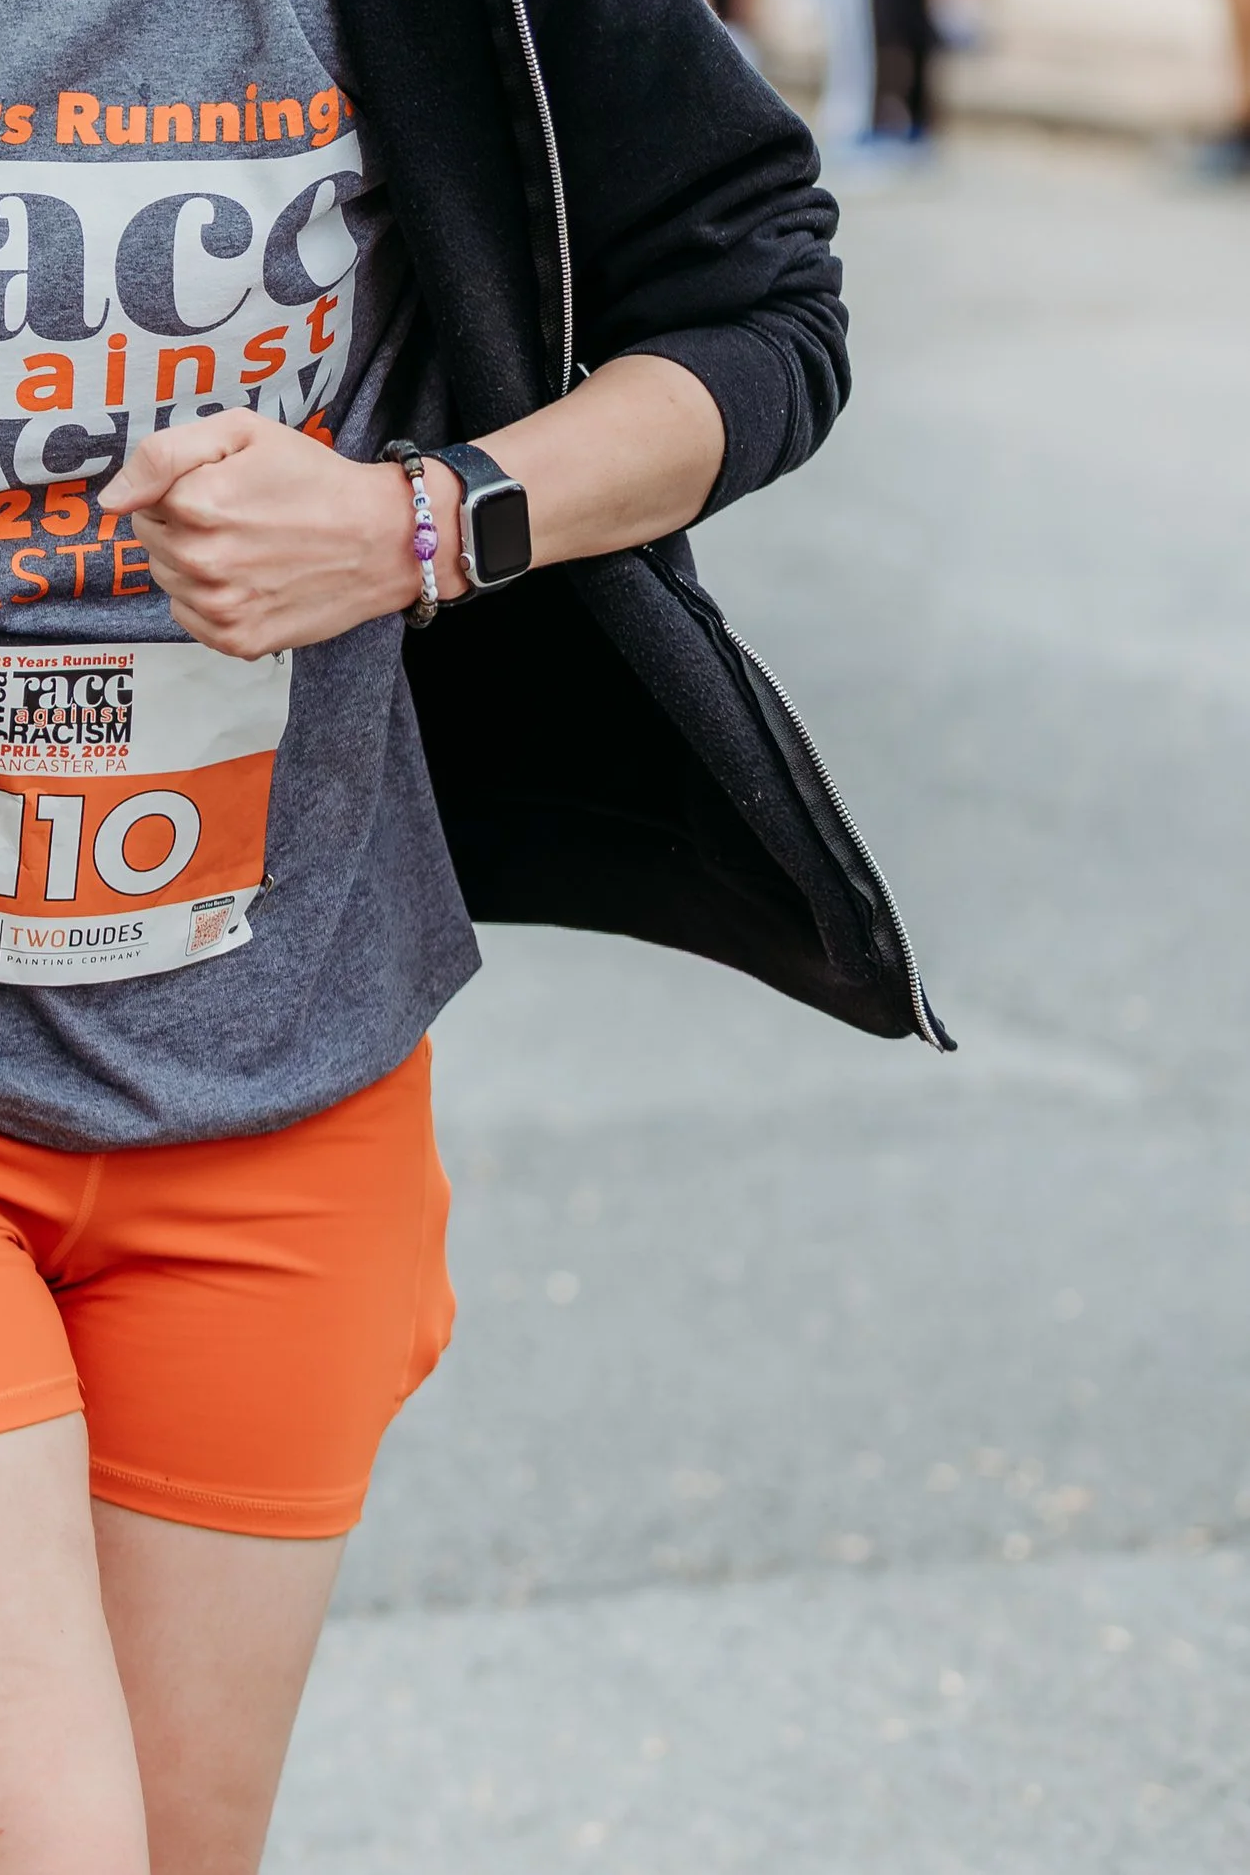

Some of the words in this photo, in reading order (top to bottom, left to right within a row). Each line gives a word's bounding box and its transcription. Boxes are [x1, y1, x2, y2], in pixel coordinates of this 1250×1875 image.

[55, 83, 354, 148] Running
[16, 656, 58, 668] Years
[62, 653, 134, 668] Running!
[11, 674, 134, 710] race
[14, 703, 128, 728] against
[8, 722, 131, 744] RACISM
[45, 744, 76, 760] 25,
[81, 744, 129, 758] 2026
[105, 758, 127, 772] PA
[6, 955, 74, 966] PAINTING
[81, 950, 142, 965] COMPANY
